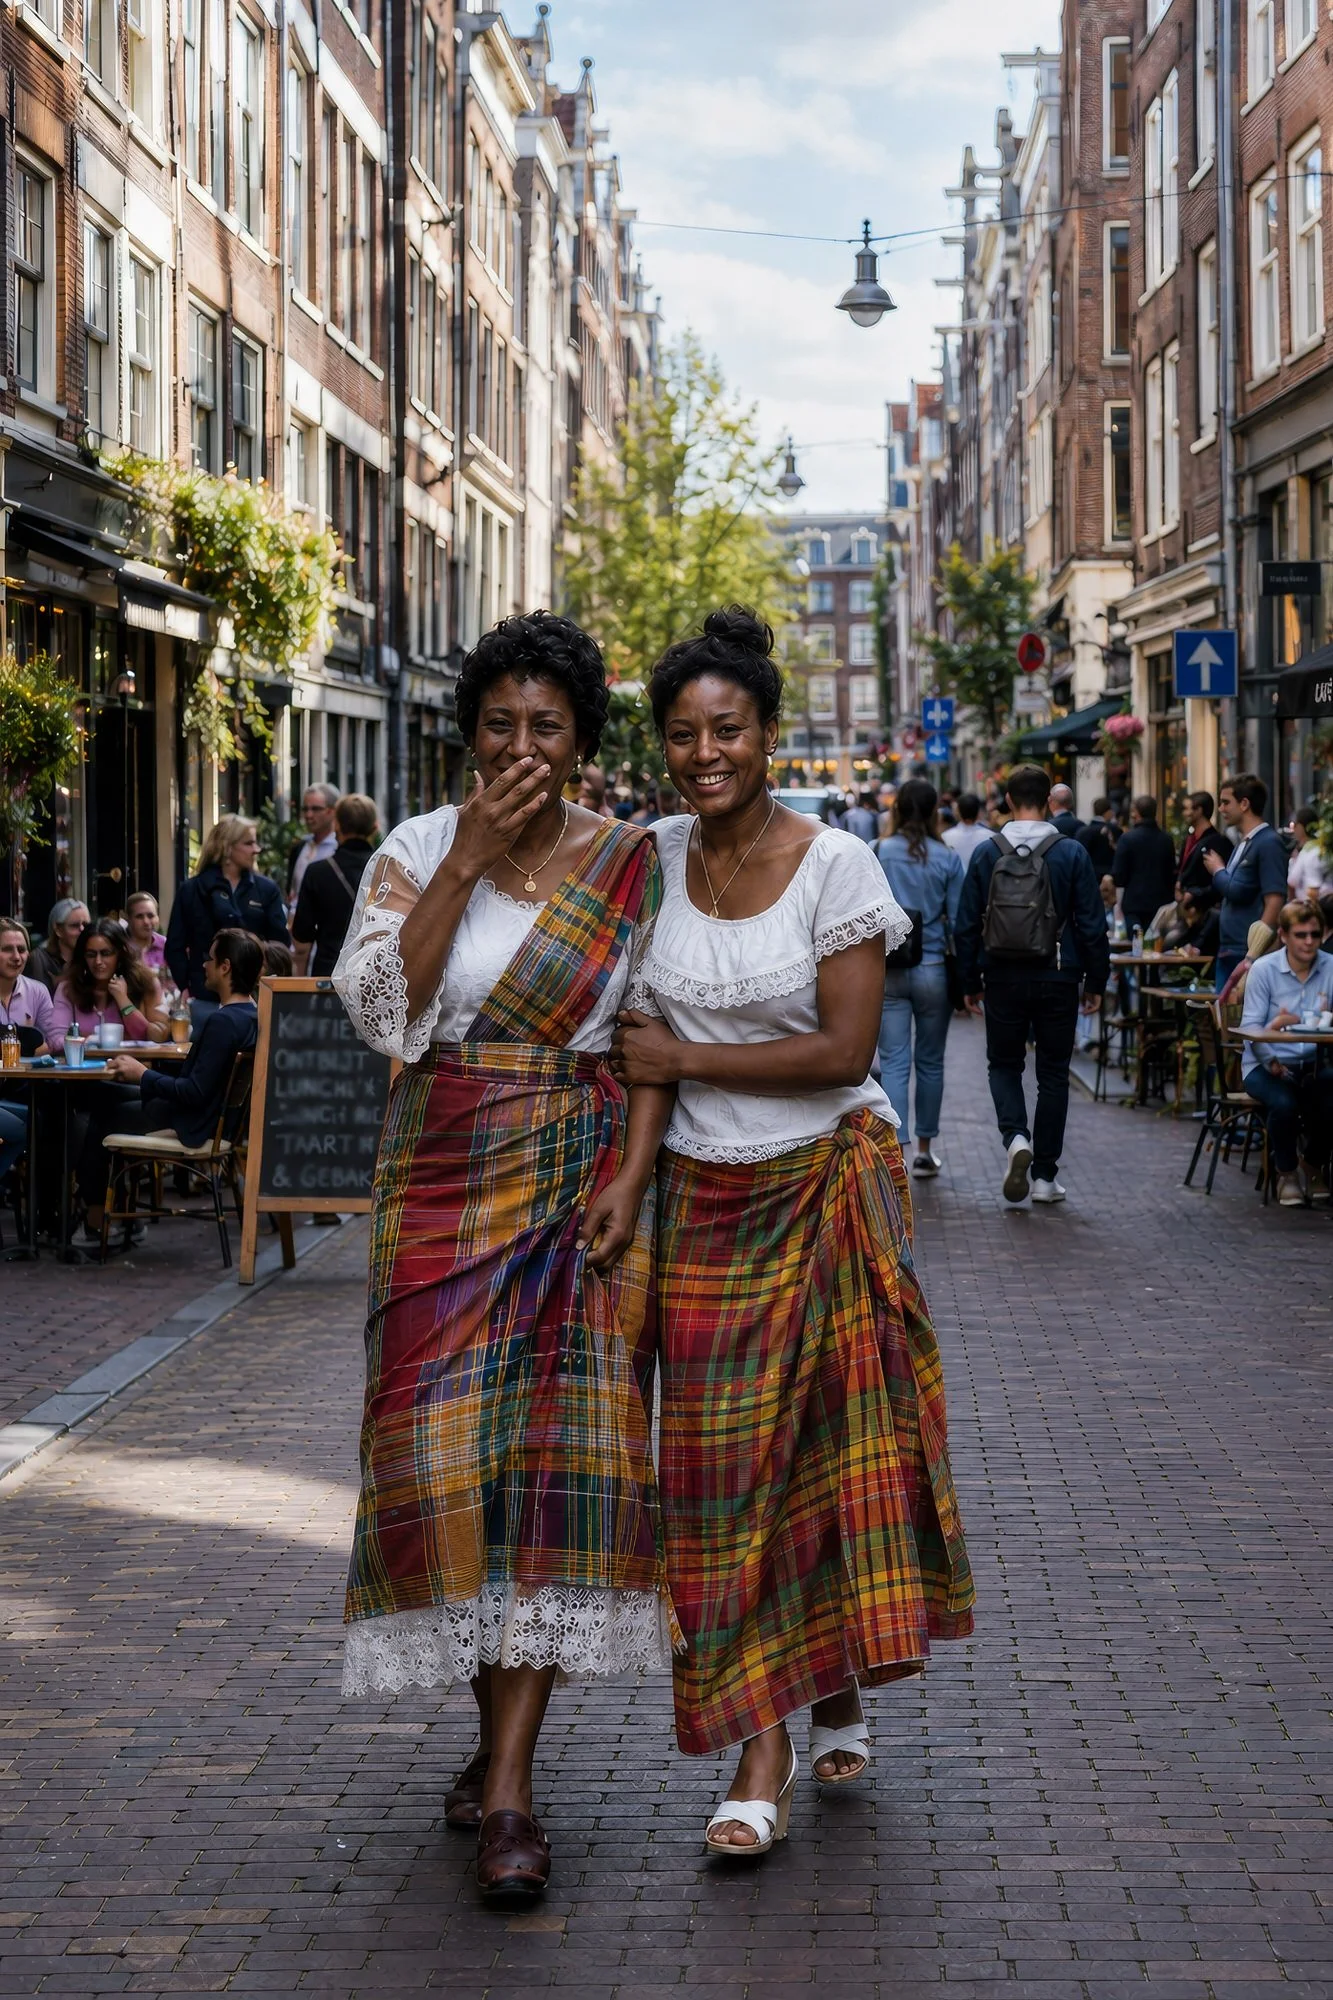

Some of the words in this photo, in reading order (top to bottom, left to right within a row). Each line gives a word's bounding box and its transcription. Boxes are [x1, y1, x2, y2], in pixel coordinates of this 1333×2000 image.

[276, 1133, 354, 1154] TAART
[272, 1163, 292, 1188] &
[300, 1163, 372, 1188] GEBAK
